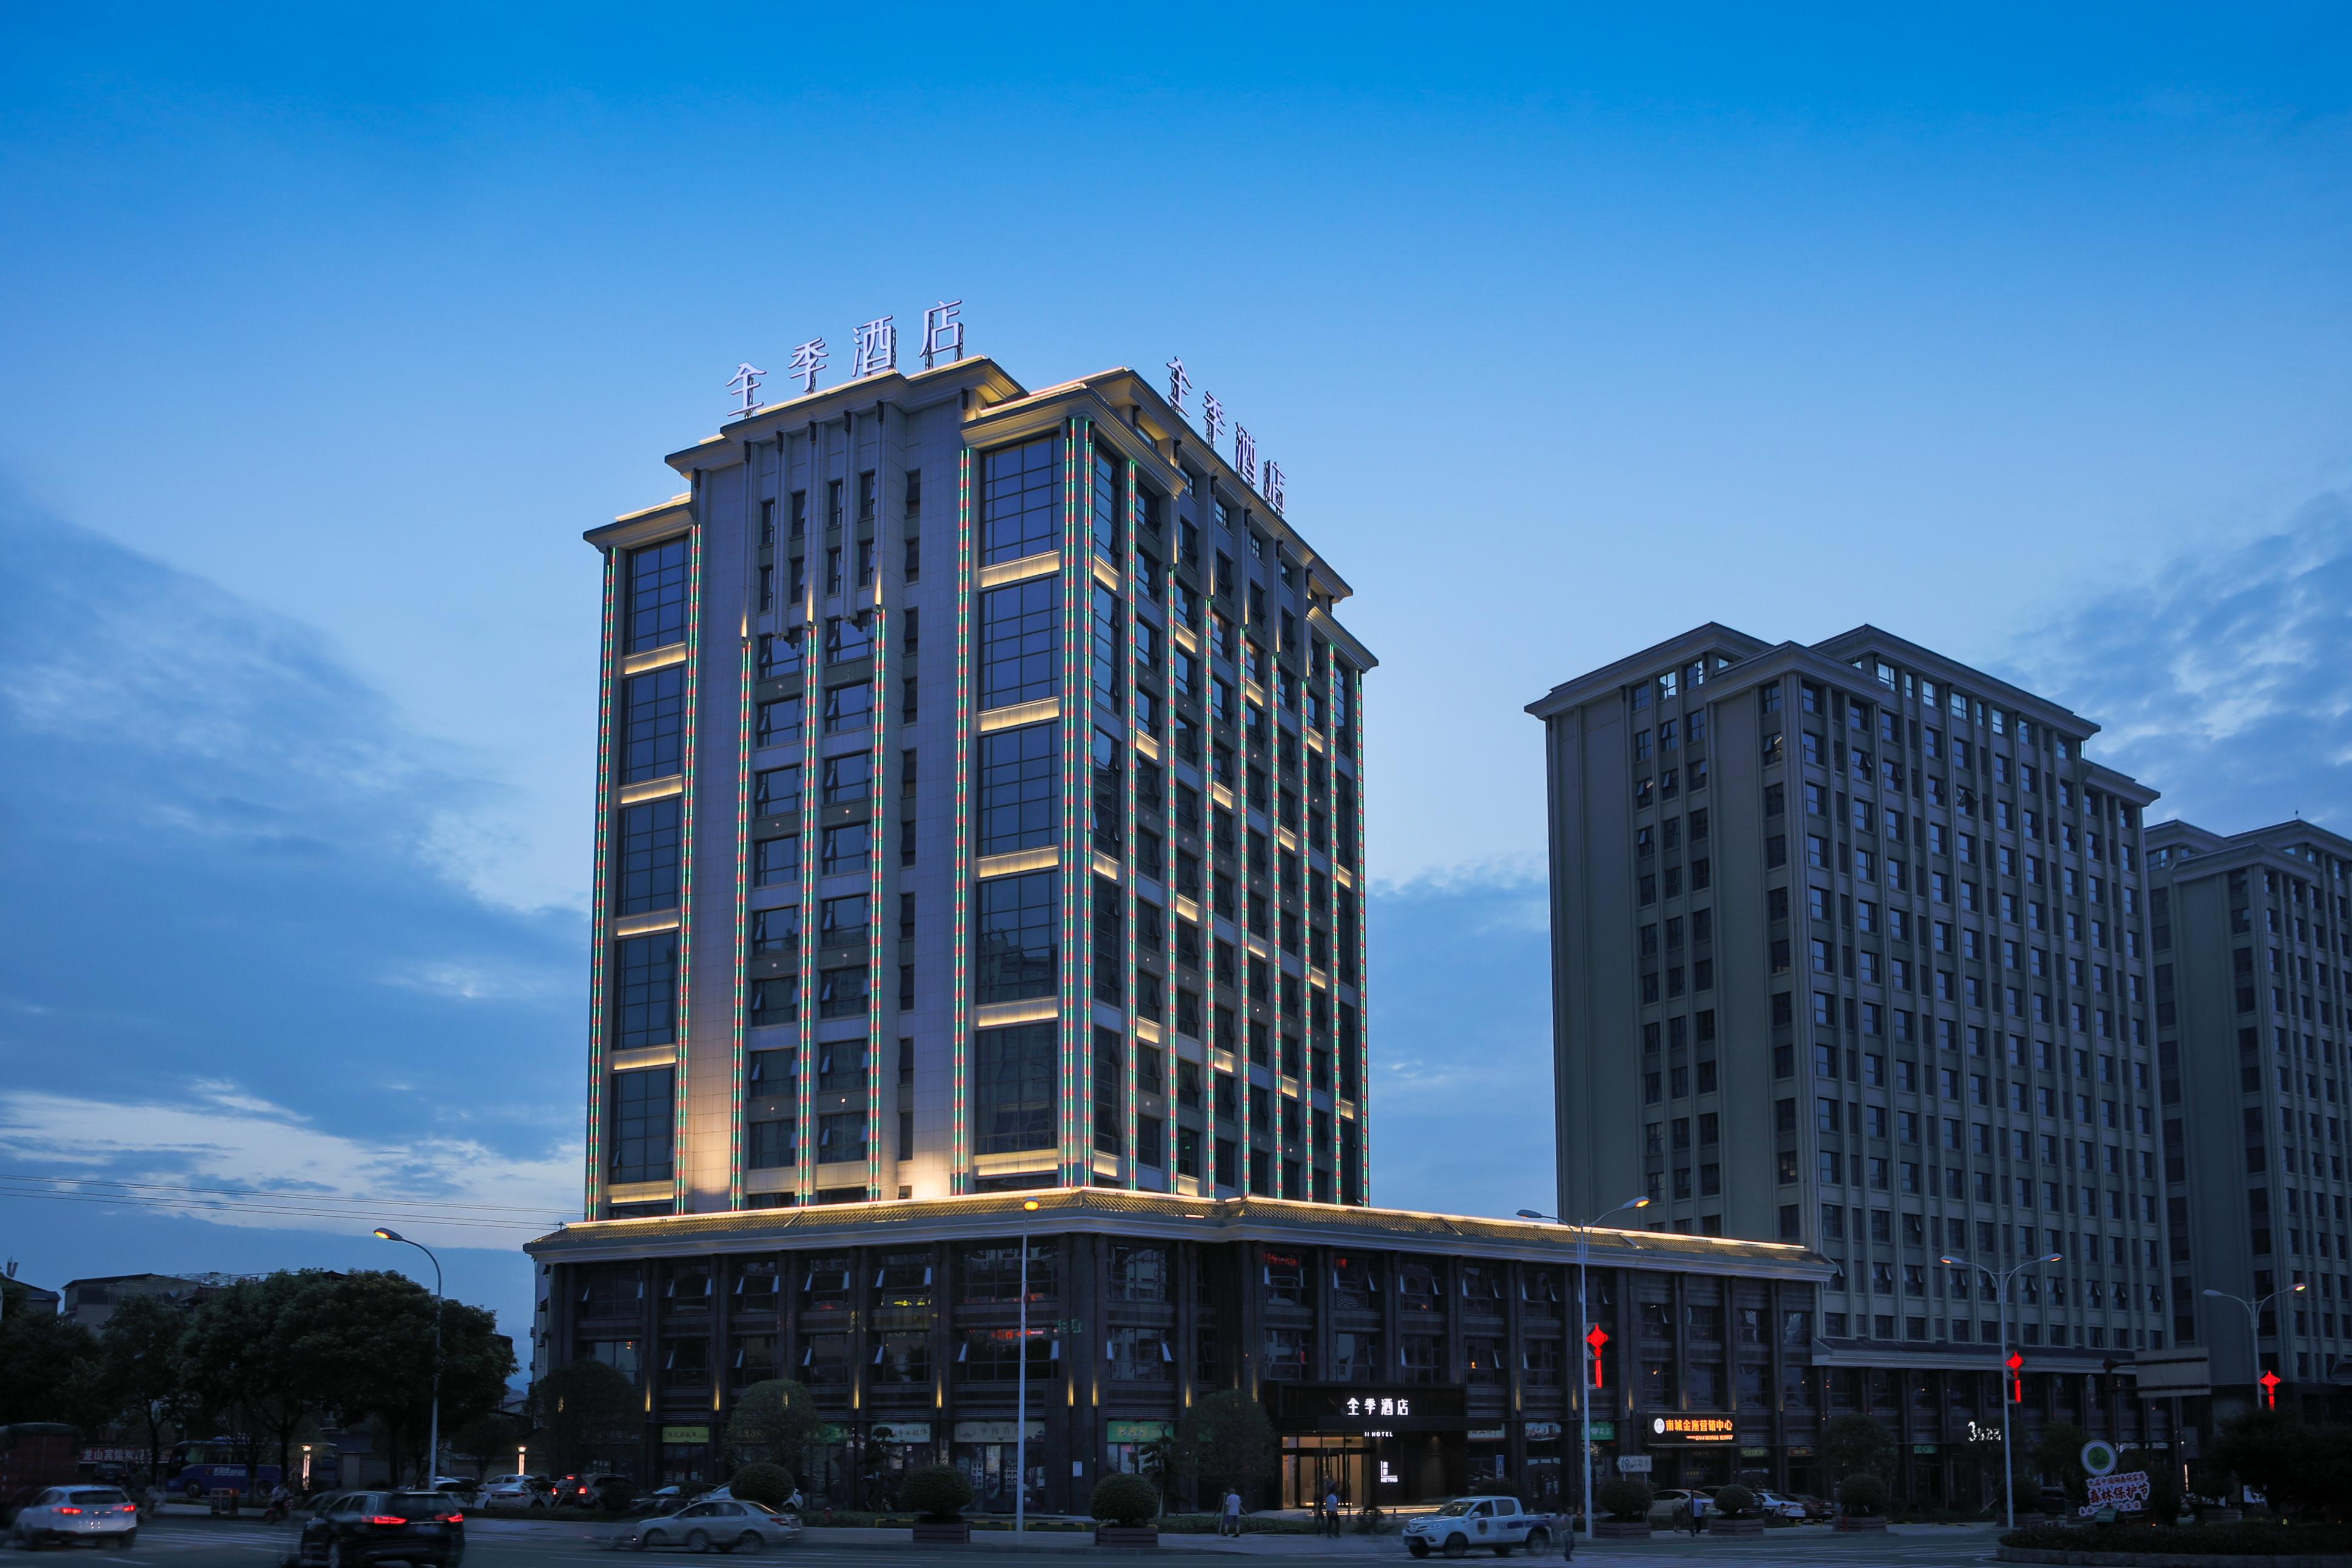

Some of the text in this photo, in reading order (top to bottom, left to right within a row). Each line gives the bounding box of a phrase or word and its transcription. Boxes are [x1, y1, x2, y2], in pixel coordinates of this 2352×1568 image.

[726, 299, 963, 417] 全季酒店
[1167, 356, 1285, 514] 全季酒店
[1347, 1397, 1409, 1415] 全季酒店
[1666, 1419, 1733, 1431] 南城金座营销中心
[2089, 1482, 2148, 1503] 森林保护节
